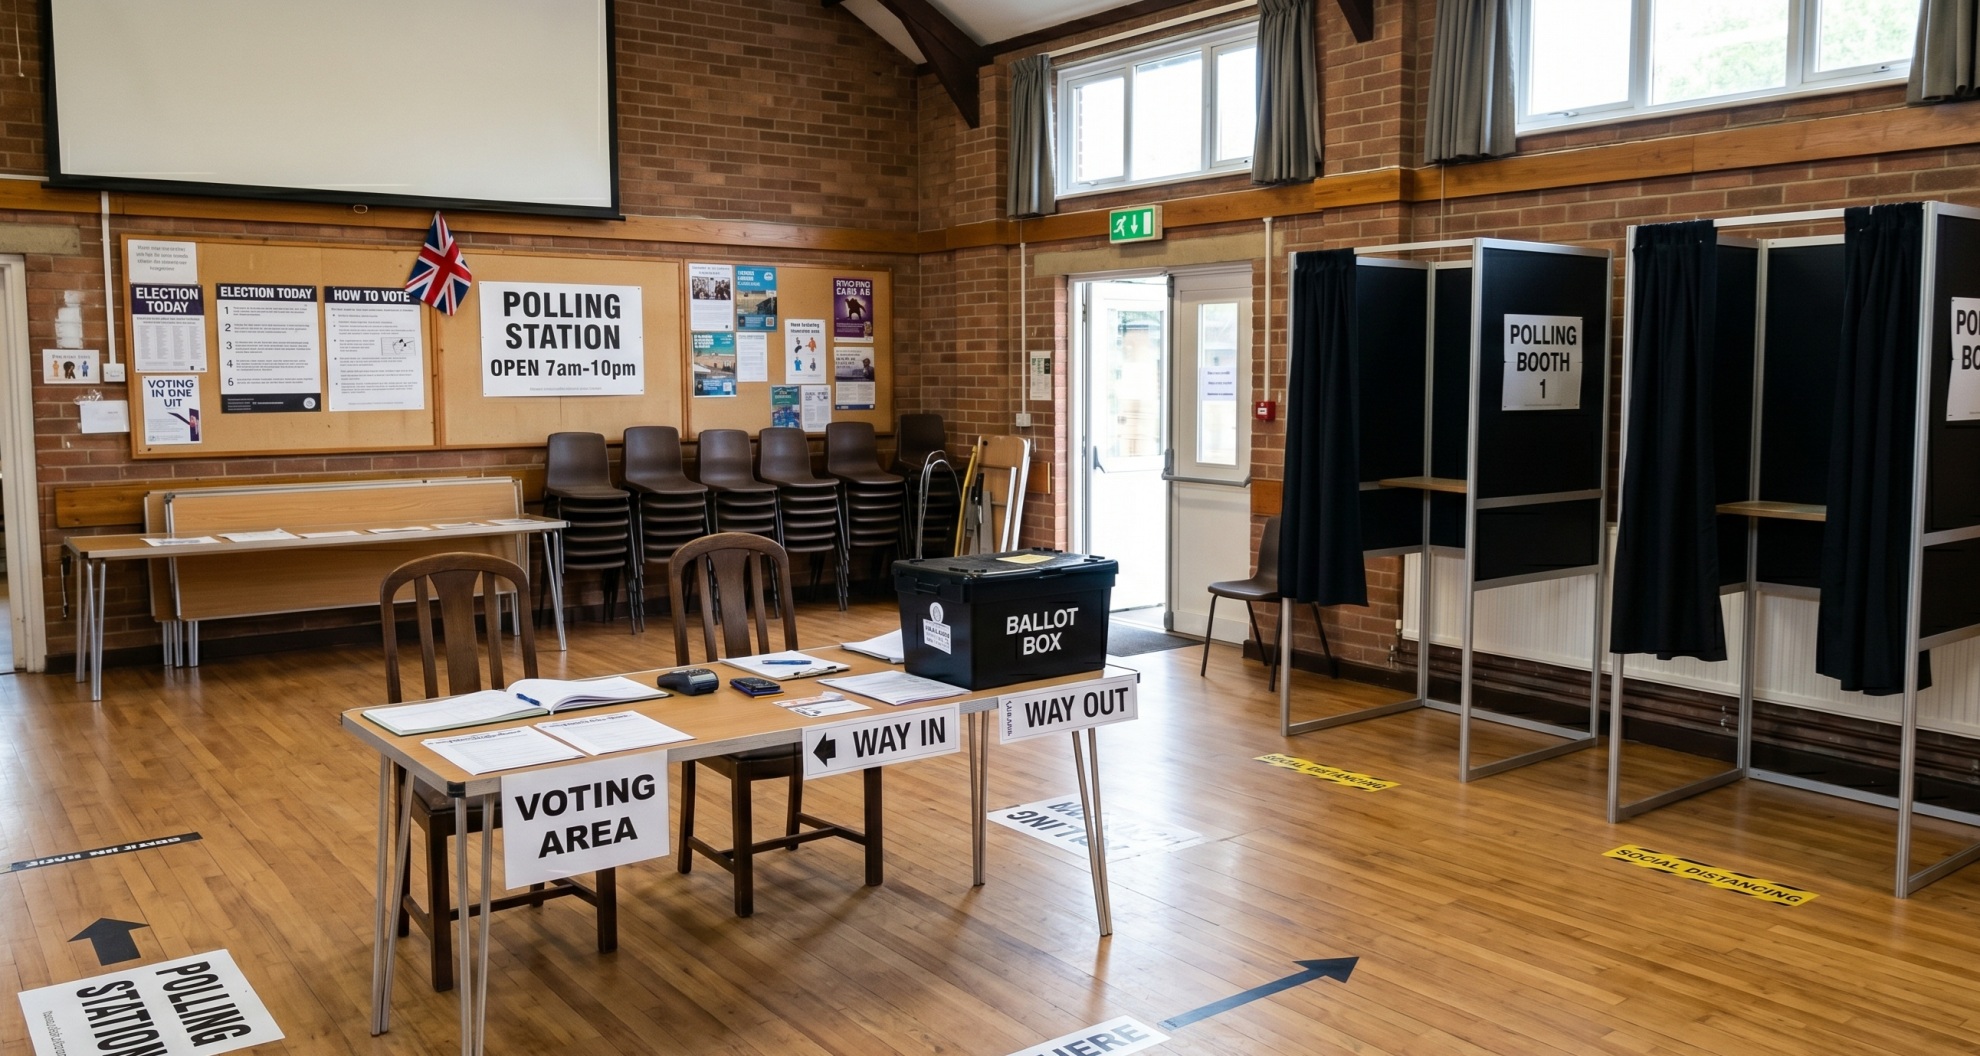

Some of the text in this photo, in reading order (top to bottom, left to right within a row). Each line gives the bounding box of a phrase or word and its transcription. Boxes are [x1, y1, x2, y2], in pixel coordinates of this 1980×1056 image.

[136, 287, 199, 300] ELECTION
[220, 286, 313, 299] ELECTION TODAY
[333, 289, 411, 303] HOW TO VOTE
[146, 301, 189, 313] TODAY
[224, 306, 229, 315] 1
[502, 290, 622, 319] POLLING
[224, 323, 231, 332] 2
[1956, 309, 1980, 335] PO
[226, 341, 233, 350] 3
[505, 322, 621, 350] STATION
[1509, 323, 1577, 346] POLLING
[226, 359, 233, 368] 4
[490, 359, 636, 380] OPEN 7am-10pm
[1516, 351, 1571, 373] BOOTH
[147, 379, 194, 389] VOTING
[151, 389, 192, 398] IN ONE
[1538, 378, 1546, 399] 1
[164, 398, 183, 407] UIT
[1006, 607, 1079, 636] BALLOT
[1022, 633, 1062, 656] BOX
[1024, 695, 1076, 729] WAY
[1083, 687, 1129, 718] OUT
[852, 716, 946, 759] WAY IN
[514, 773, 656, 822] VOTING
[538, 816, 639, 859] AREA
[1616, 849, 1804, 903] SOCIAL DISTANCING
[155, 961, 252, 1048] POLLING
[1037, 1024, 1151, 1056] ERE
